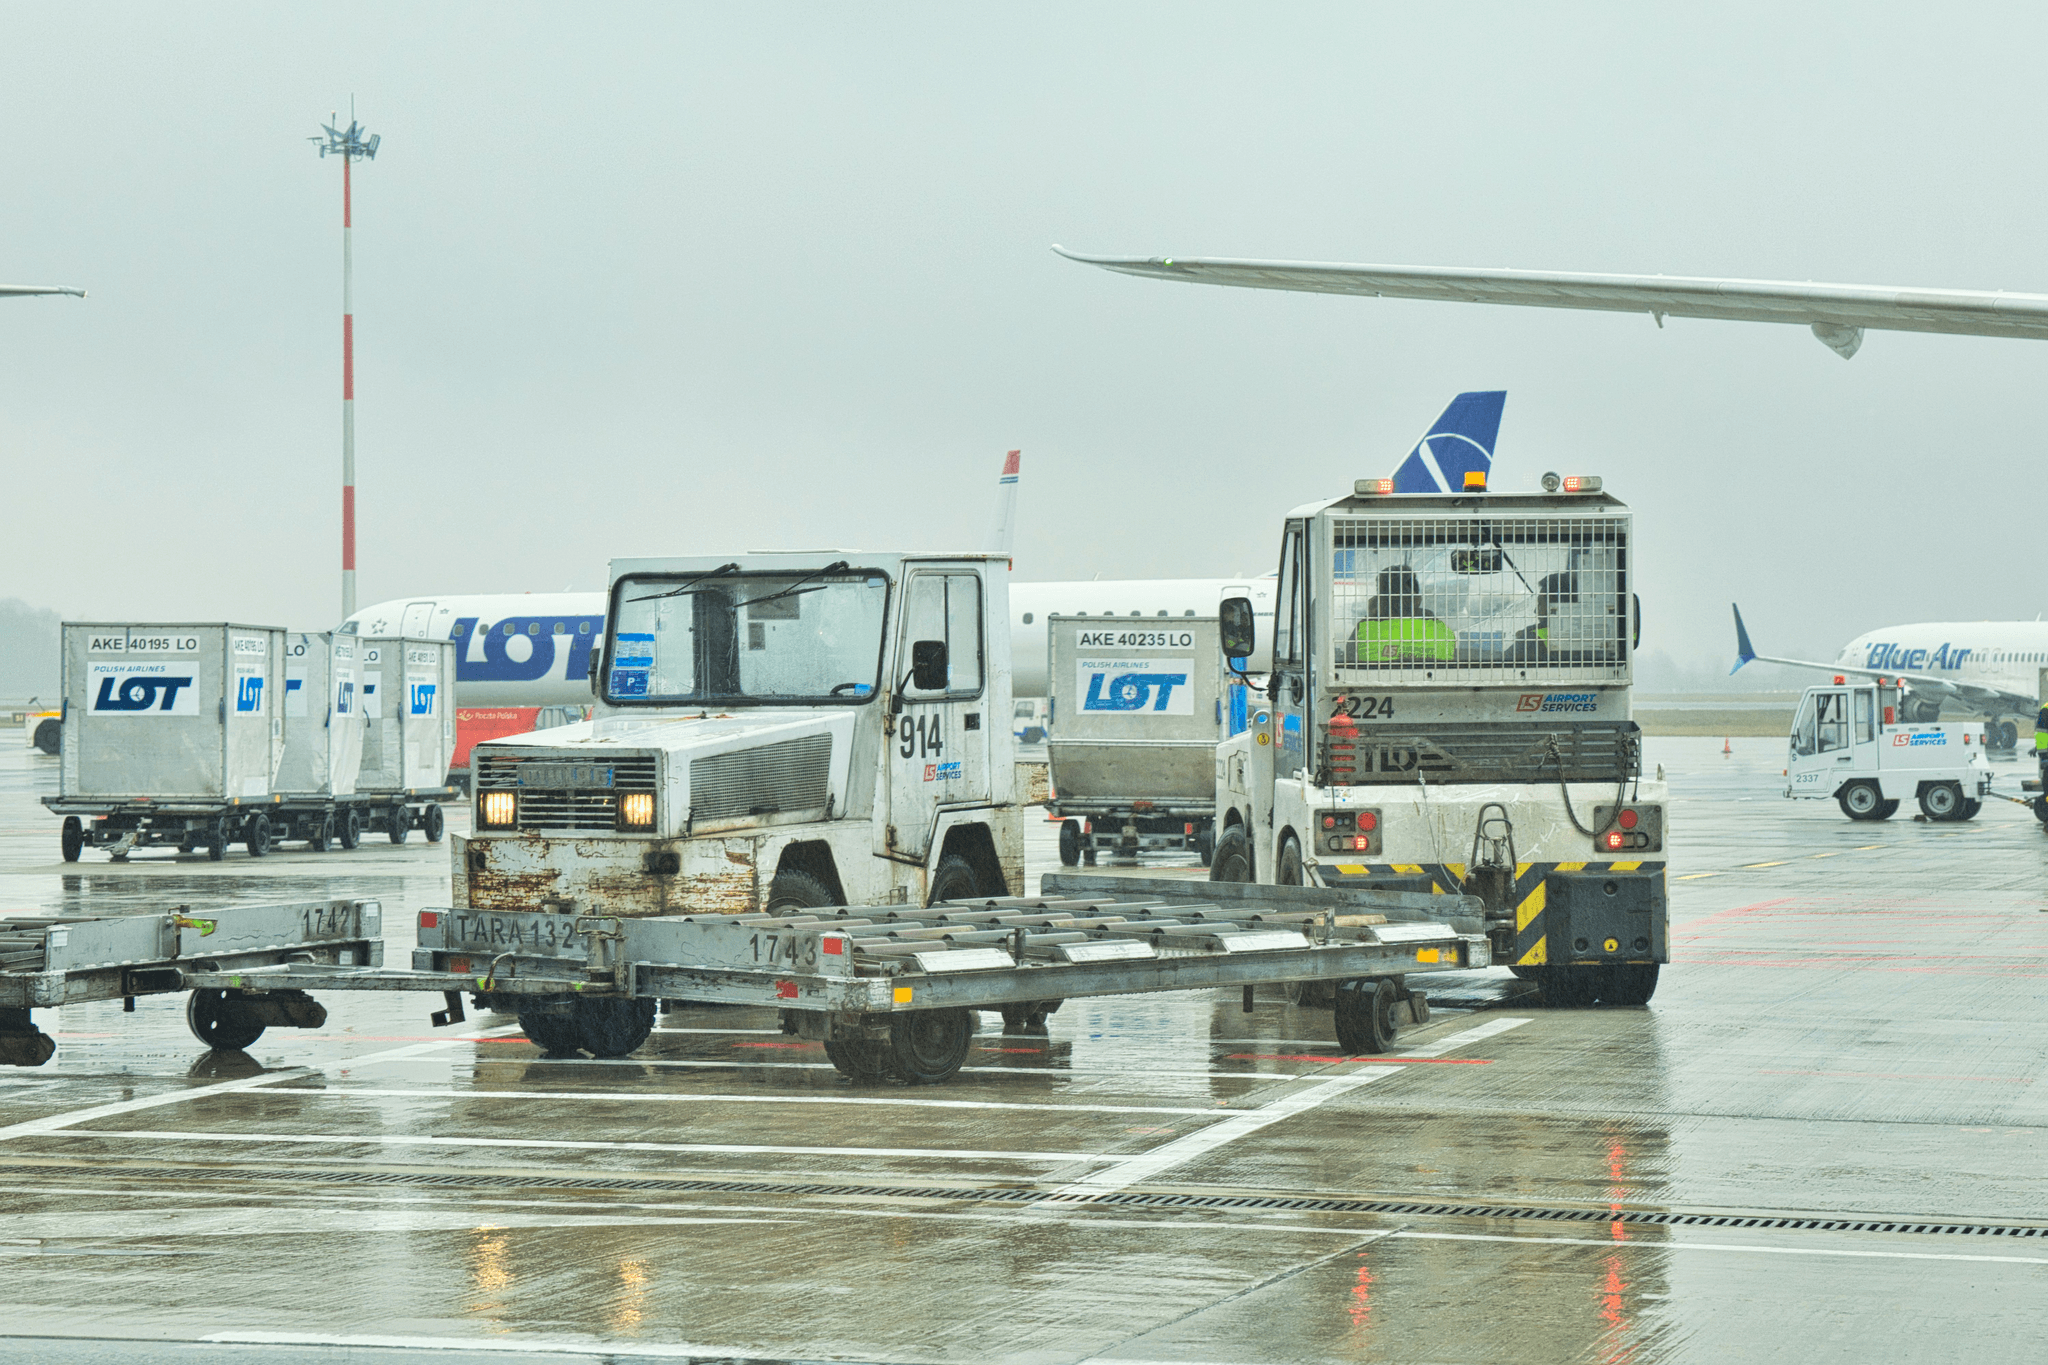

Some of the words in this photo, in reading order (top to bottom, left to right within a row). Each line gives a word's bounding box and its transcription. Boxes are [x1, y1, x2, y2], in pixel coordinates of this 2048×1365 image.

[91, 638, 123, 650] AKE
[130, 638, 170, 650] 40195
[176, 638, 197, 650] LO
[1080, 633, 1114, 646] AKE
[1118, 633, 1166, 646] 40235
[1170, 634, 1192, 646] LO
[286, 645, 305, 656] LO
[363, 651, 378, 661] O
[449, 615, 604, 682] LOT
[1866, 643, 1927, 670] Blue
[1928, 643, 1972, 670] Air
[94, 676, 193, 711] LOT
[237, 677, 263, 711] LOT
[337, 682, 354, 713] LOT
[411, 684, 436, 714] LOT
[1083, 673, 1187, 711] LOT
[1544, 694, 1597, 702] AIRPORT
[1518, 695, 1543, 712] LS
[1541, 703, 1597, 712] SERVICES
[900, 713, 943, 759] 914
[1894, 734, 1909, 746] LS
[924, 764, 936, 781] LS
[936, 770, 961, 781] SERVICES
[937, 762, 961, 772] AIRPORT
[1796, 774, 1819, 783] 2337
[304, 905, 350, 937] 1742
[456, 915, 523, 944] TARA
[530, 920, 588, 950] 132
[749, 933, 817, 966] 1743
